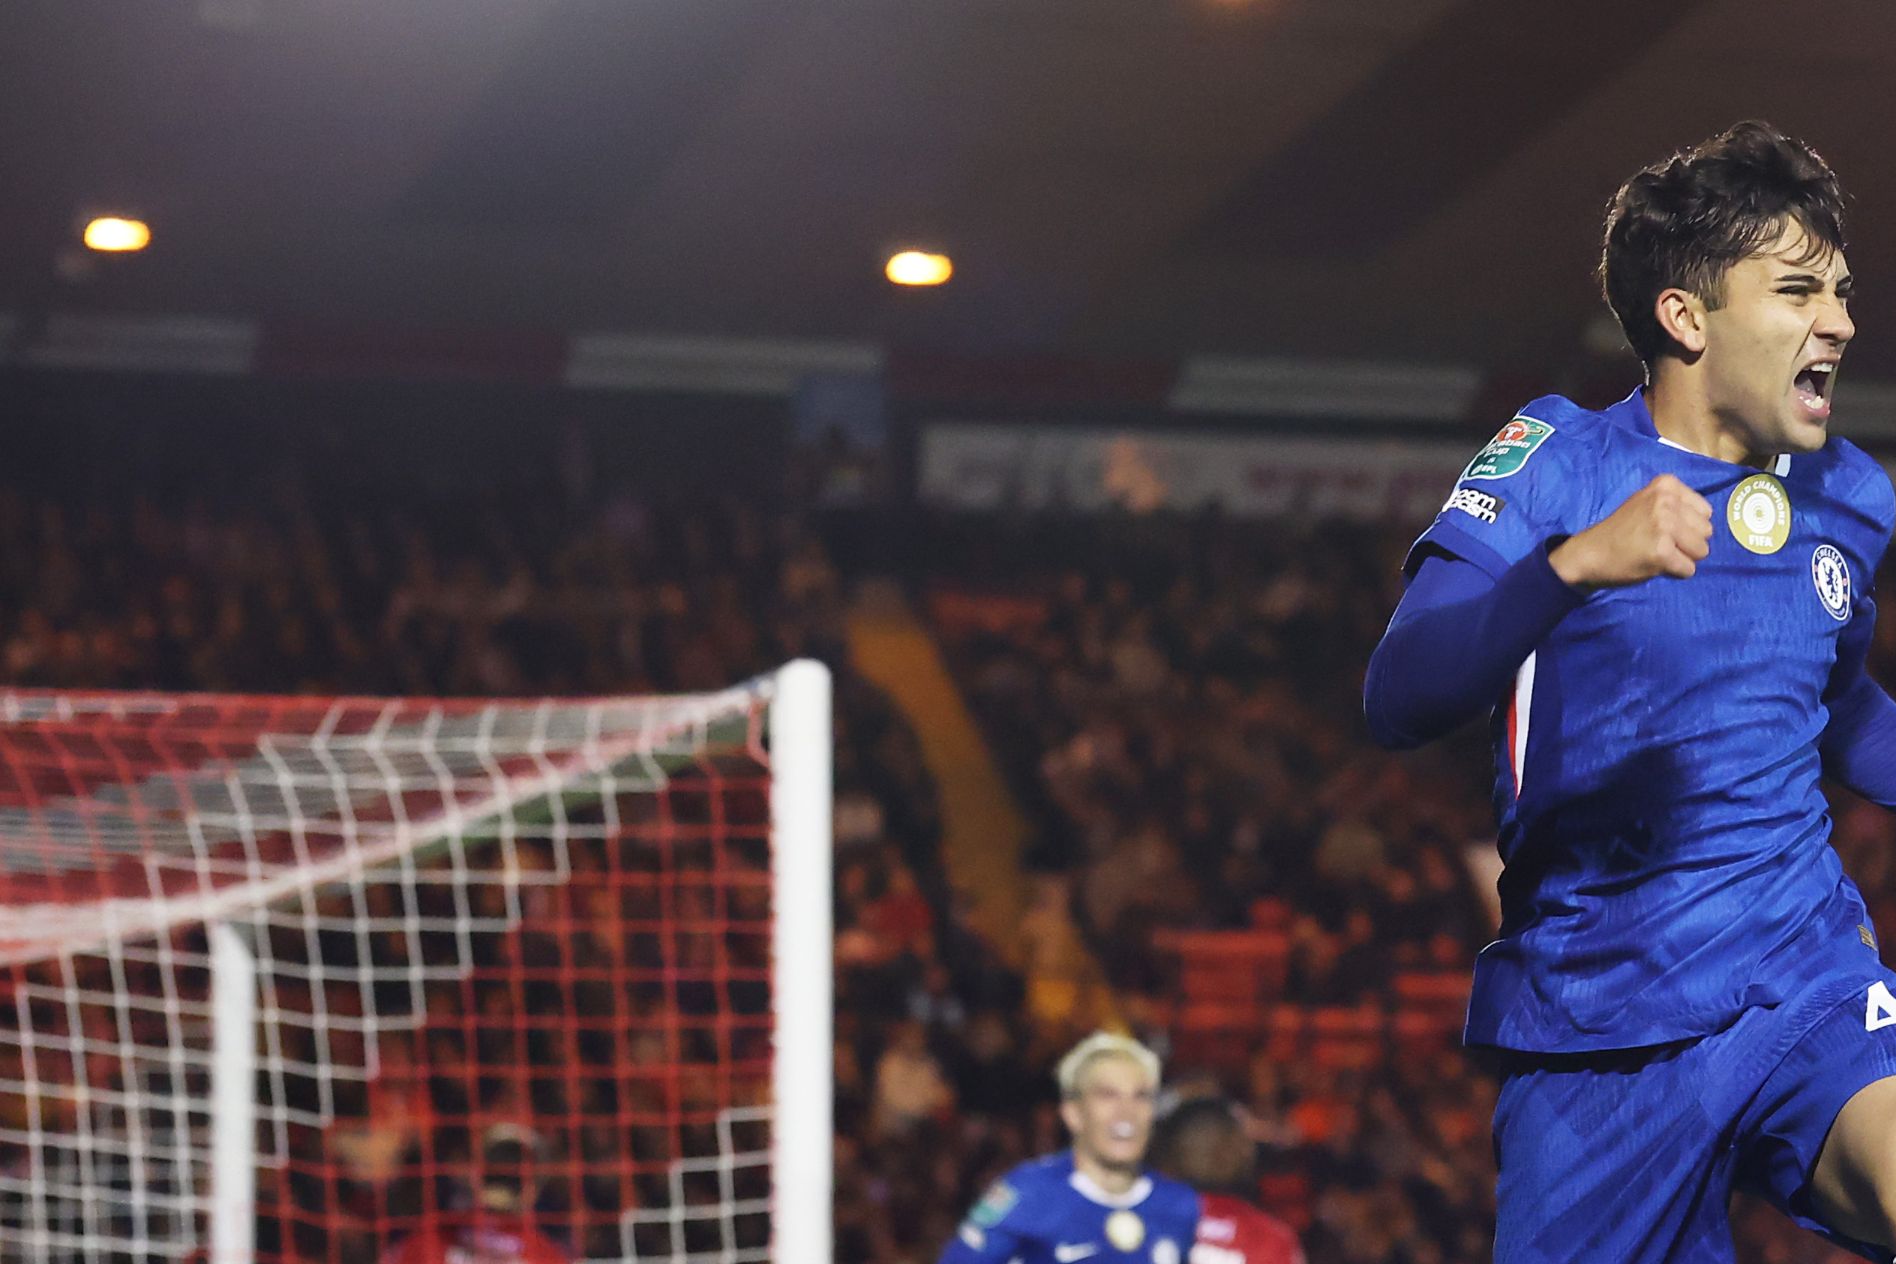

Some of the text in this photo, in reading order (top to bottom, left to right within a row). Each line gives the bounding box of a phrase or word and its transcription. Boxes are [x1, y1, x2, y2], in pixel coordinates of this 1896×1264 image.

[1733, 480, 1786, 526] WORLD CHAMPIONS
[1748, 534, 1774, 547] FIFA
[1816, 547, 1843, 571] CHELSEA
